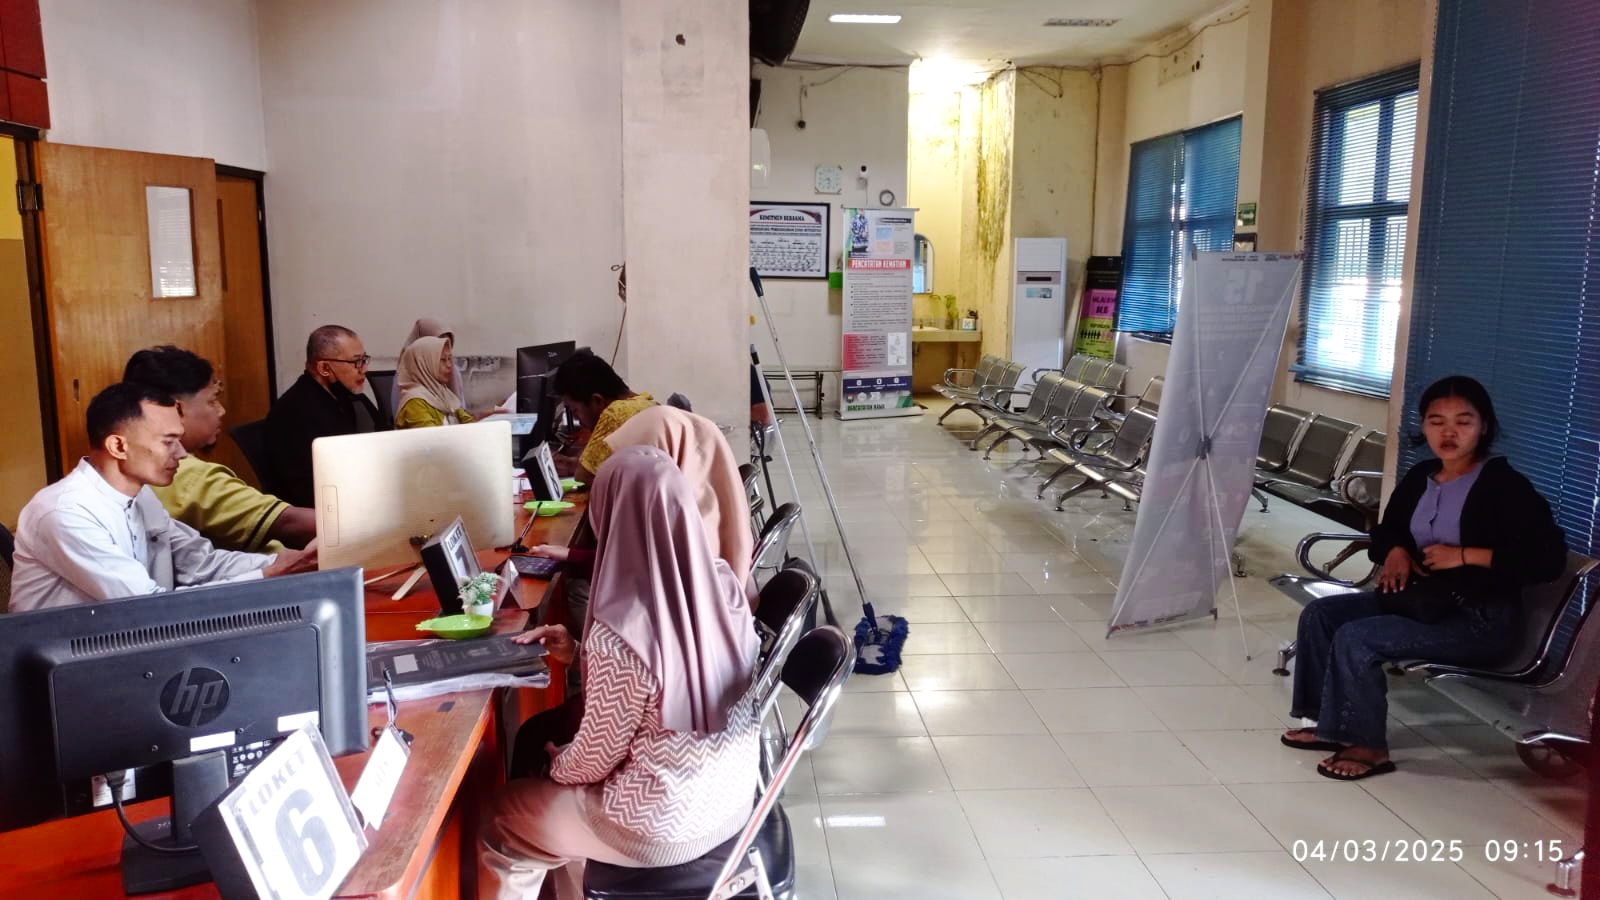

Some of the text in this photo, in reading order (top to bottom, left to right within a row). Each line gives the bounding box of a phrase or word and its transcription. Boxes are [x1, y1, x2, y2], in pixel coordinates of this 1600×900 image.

[851, 259, 907, 269] PENCATATAN KEMATIAN
[447, 526, 463, 550] LOKET
[169, 666, 224, 728] hp
[247, 745, 307, 817] LOKET
[275, 788, 337, 897] 6
